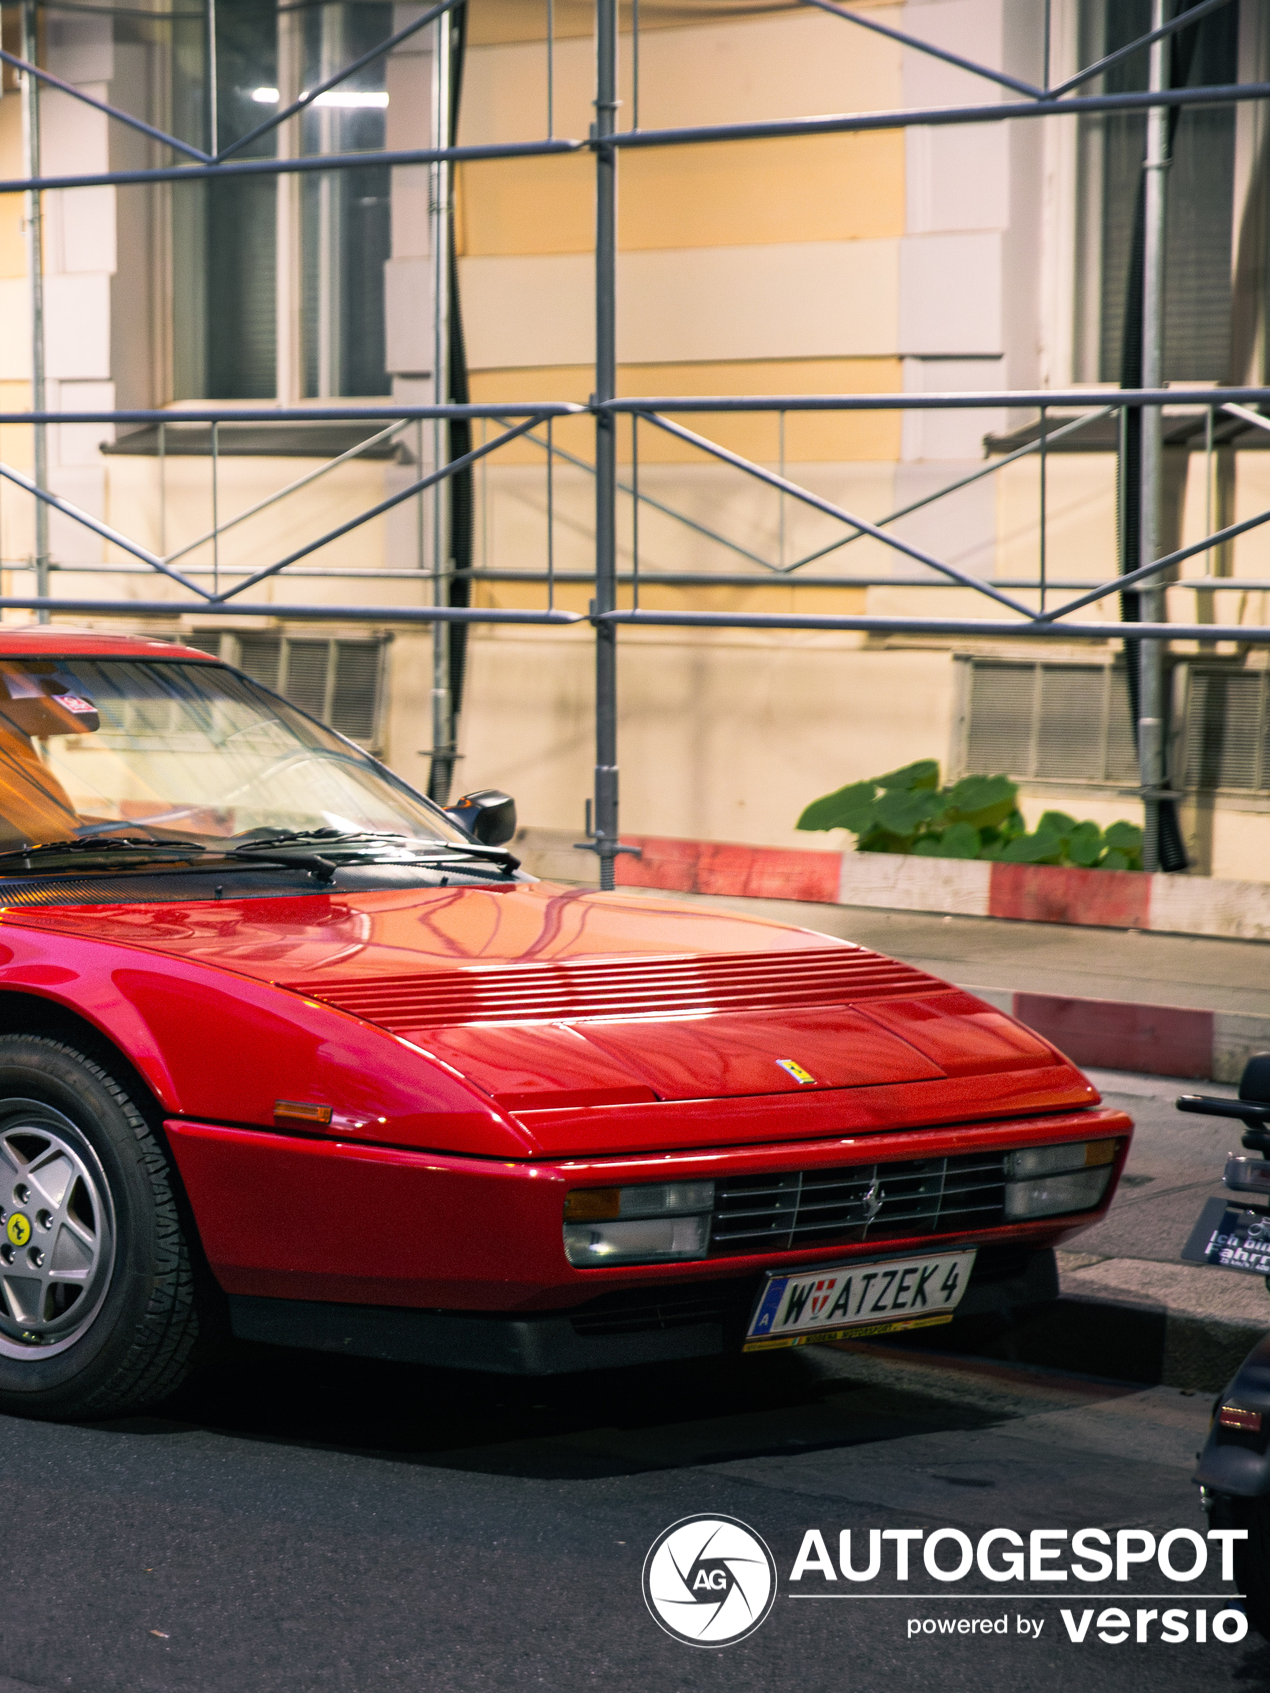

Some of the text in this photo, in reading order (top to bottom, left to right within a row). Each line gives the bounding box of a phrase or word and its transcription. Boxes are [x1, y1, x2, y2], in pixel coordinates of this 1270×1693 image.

[1210, 1230, 1239, 1246] Ich
[940, 1262, 958, 1303] 4
[758, 1313, 769, 1326] A
